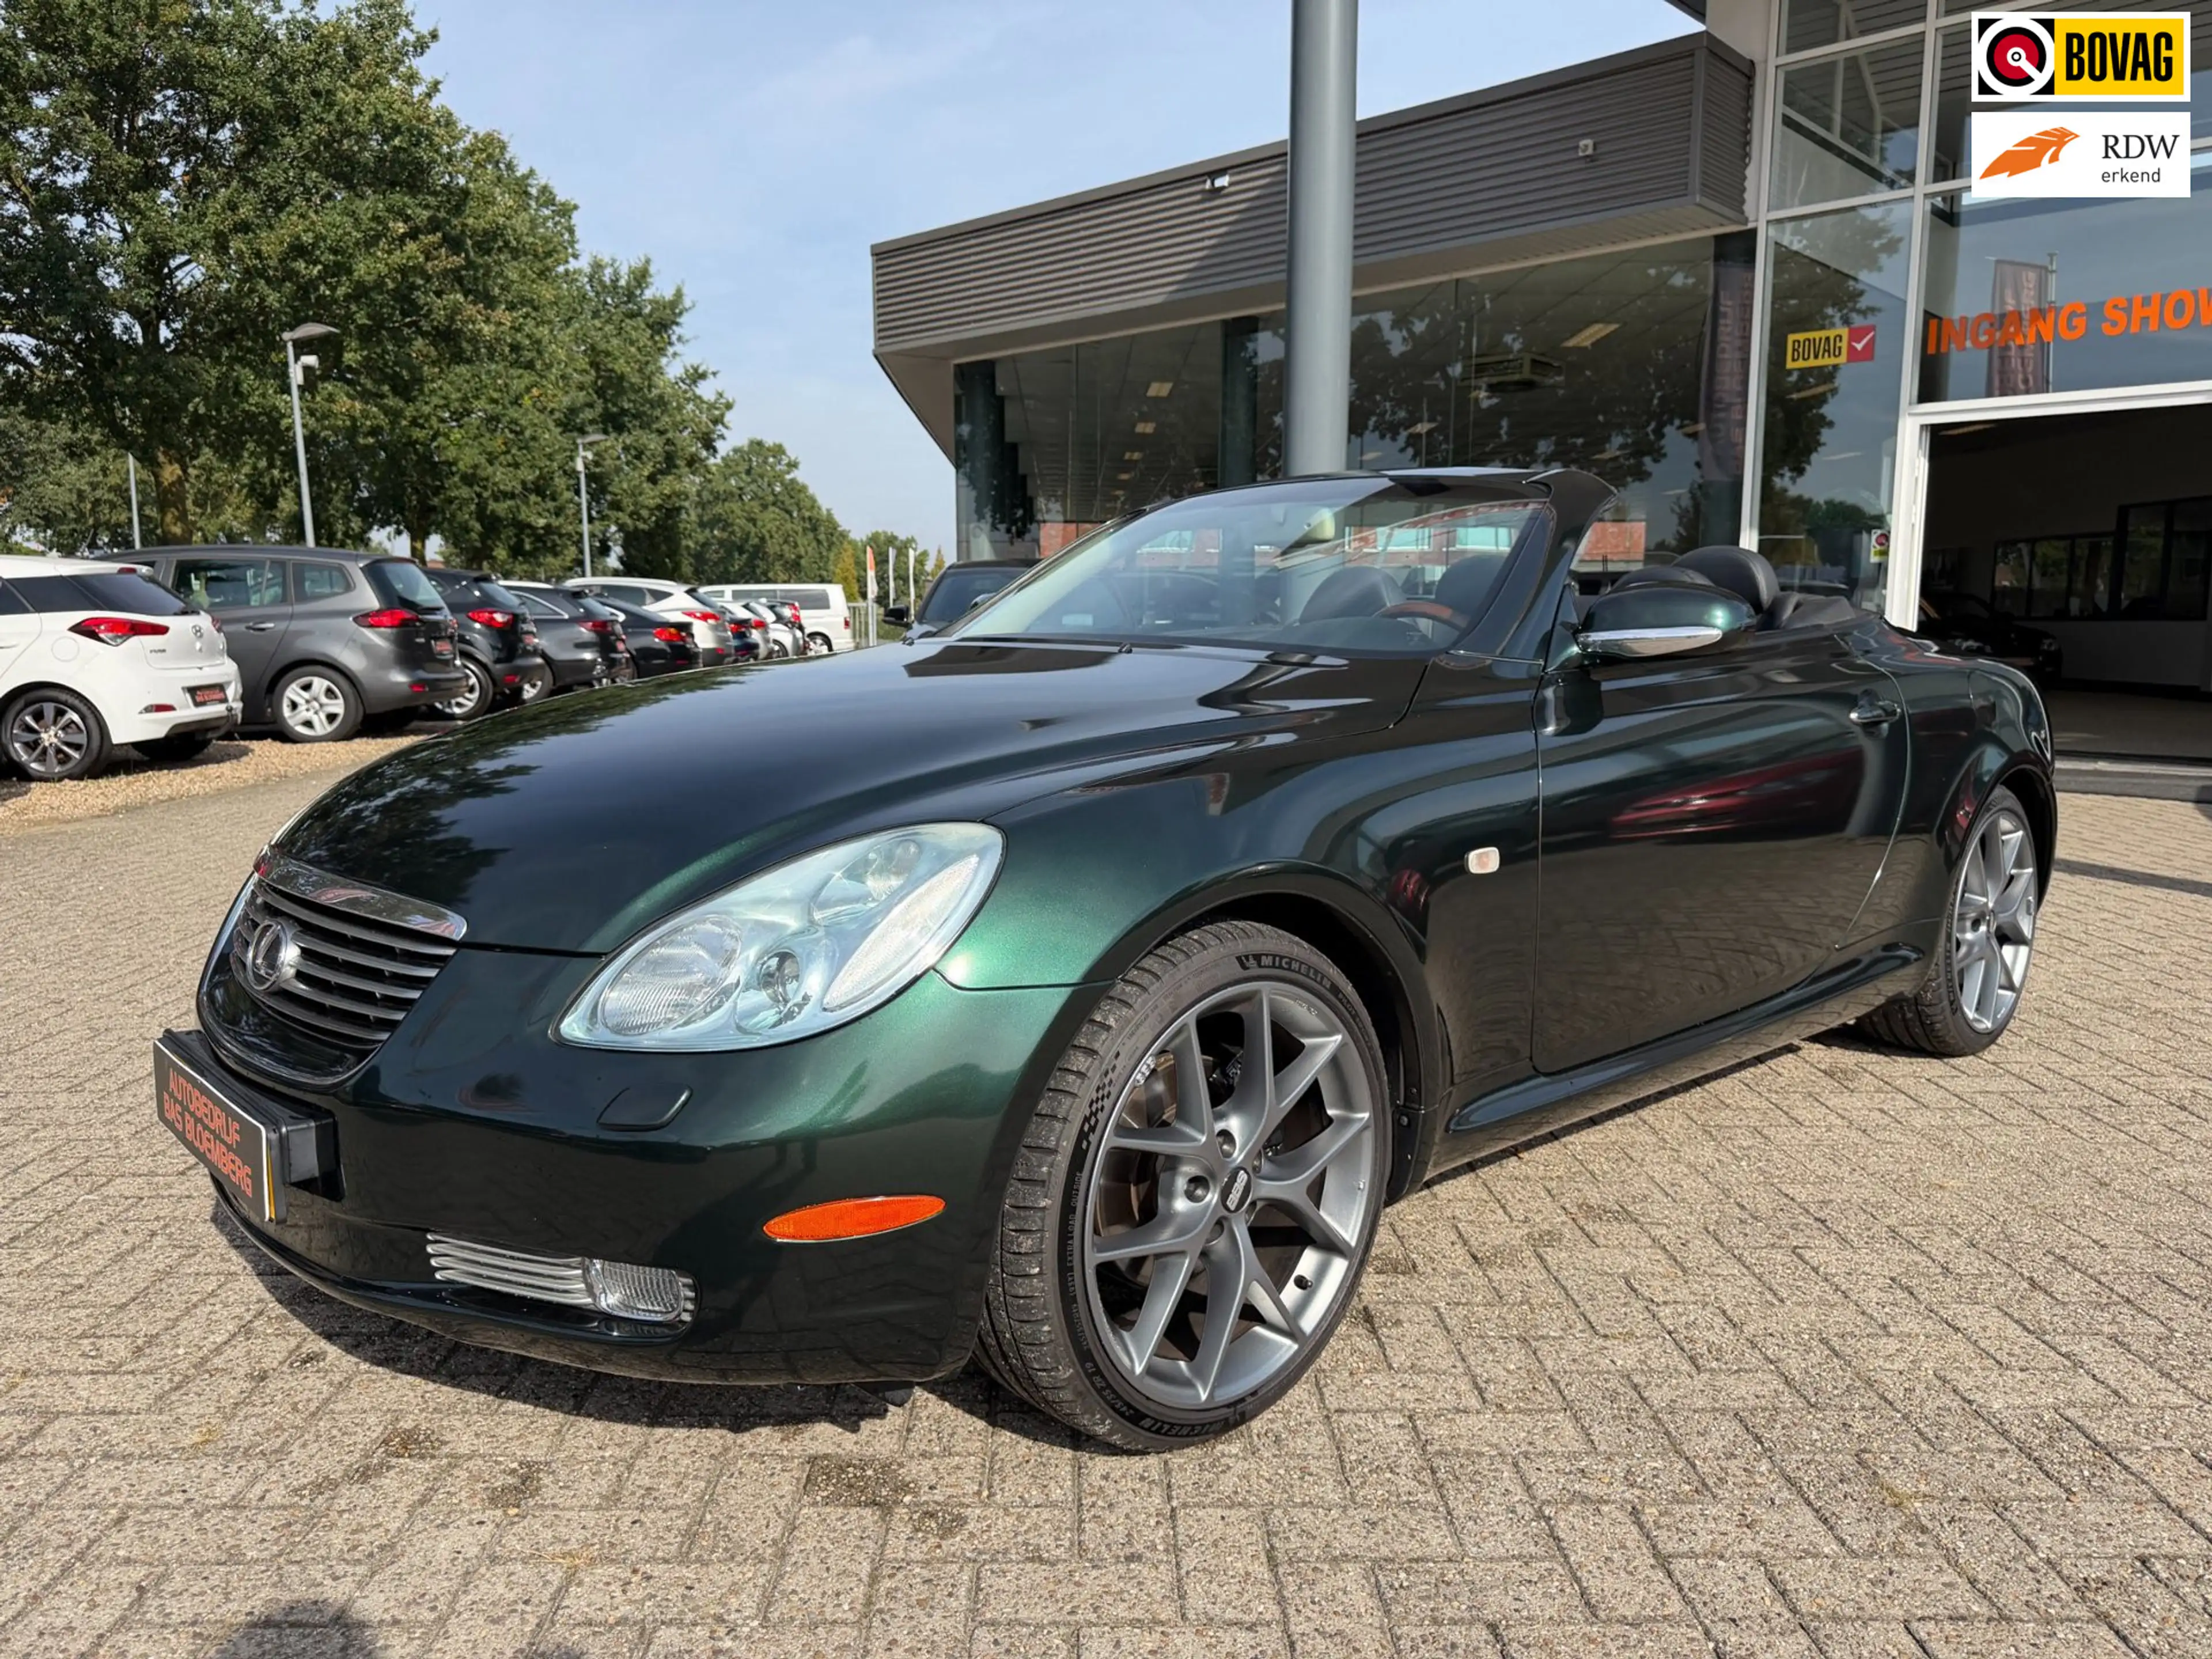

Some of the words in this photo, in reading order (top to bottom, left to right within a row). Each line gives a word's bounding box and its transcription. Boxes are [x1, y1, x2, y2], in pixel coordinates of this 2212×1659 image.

[1927, 301, 2087, 355] INGANG
[1791, 334, 1843, 362] BOVAG
[1260, 955, 1331, 990] MICHELIN
[169, 1068, 240, 1148] AUTOBEDRIJF
[164, 1091, 182, 1131] BAS
[184, 1111, 252, 1198] BLOEMBERG
[1070, 1171, 1082, 1207] OUTSIDE
[1226, 1170, 1248, 1211] BBS
[1067, 1214, 1077, 1238] LOAD
[1140, 1417, 1225, 1437] MICHELIN
